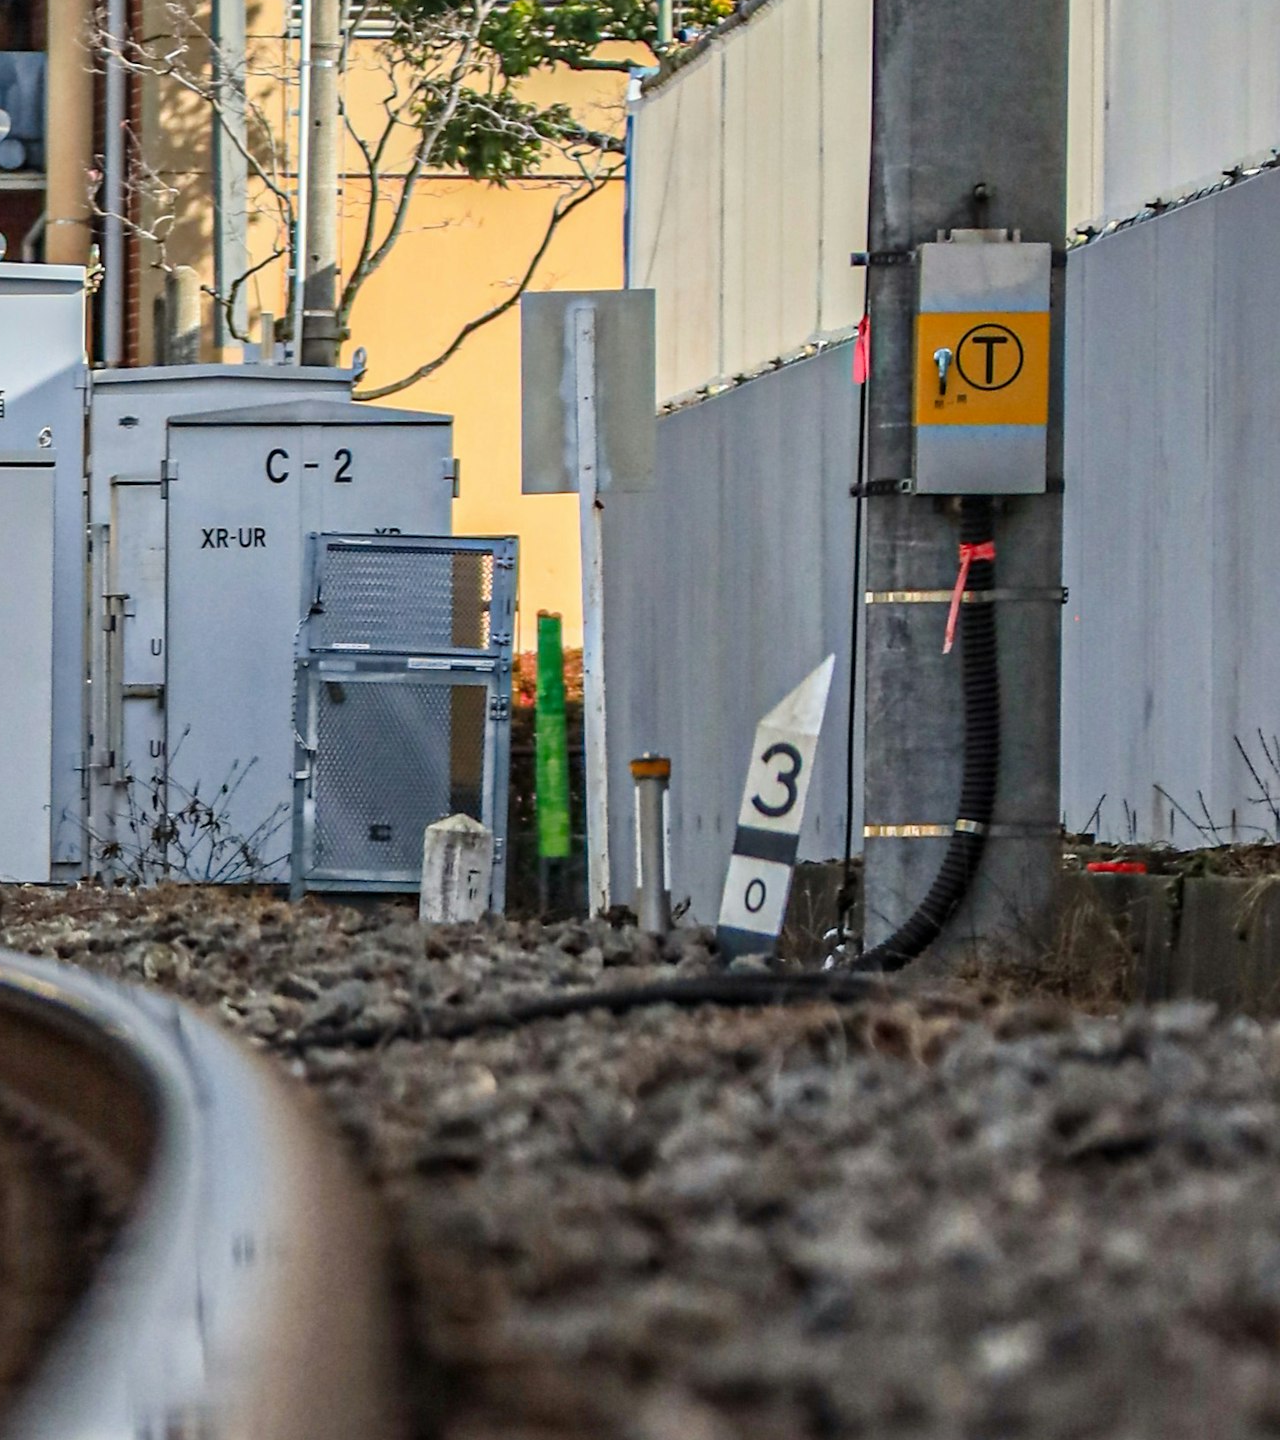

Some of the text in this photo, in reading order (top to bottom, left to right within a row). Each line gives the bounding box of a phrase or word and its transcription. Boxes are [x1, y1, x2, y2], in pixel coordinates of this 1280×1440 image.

[201, 528, 266, 548] XR-UR
[751, 741, 802, 818] 3
[744, 877, 767, 914] 0
